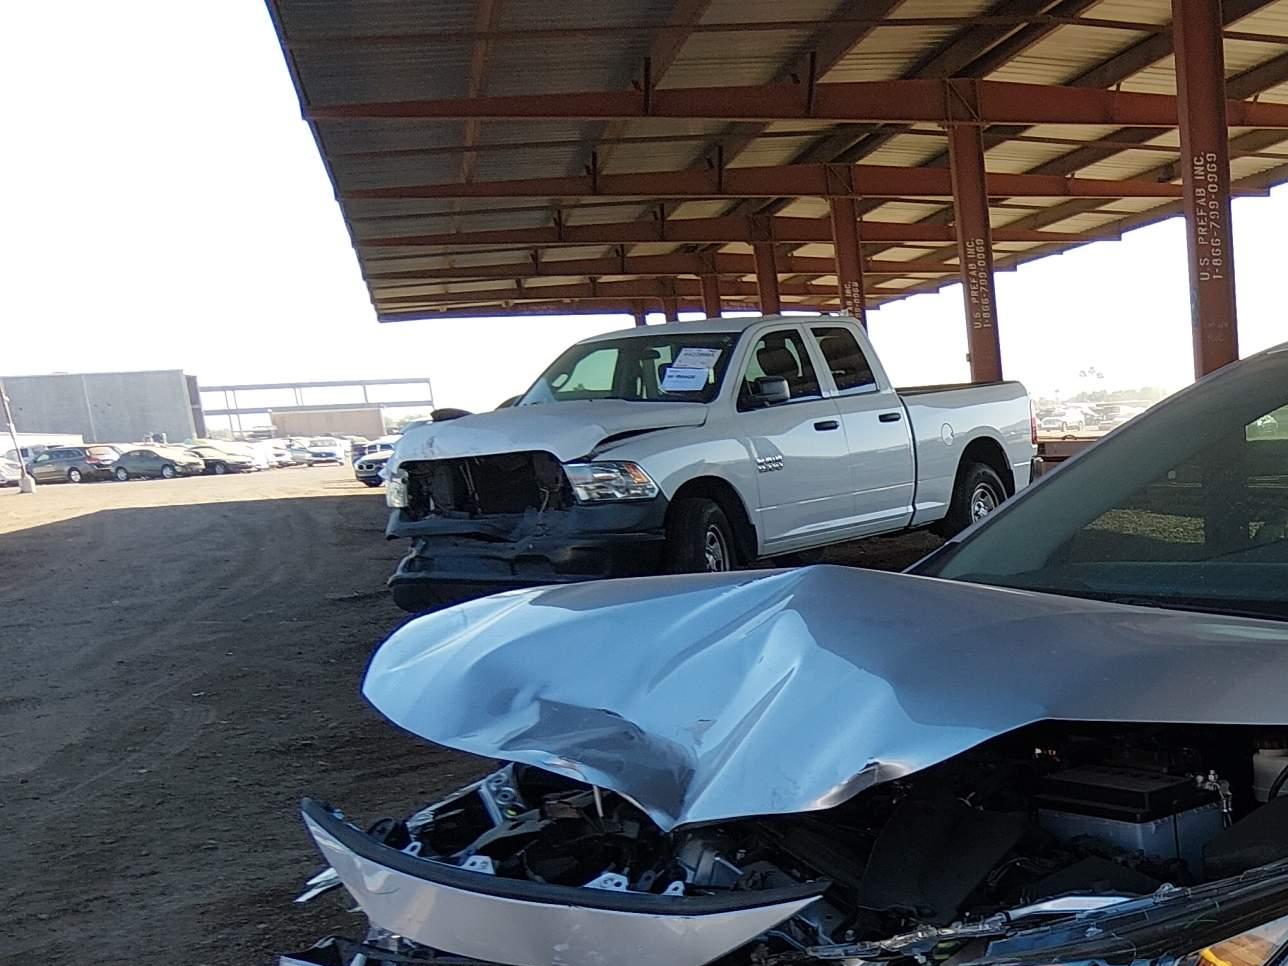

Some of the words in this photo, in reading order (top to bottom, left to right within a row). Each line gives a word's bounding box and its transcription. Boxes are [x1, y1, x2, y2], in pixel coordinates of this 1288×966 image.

[1193, 151, 1205, 182] INC.
[1195, 188, 1209, 245] PREFAB
[1206, 152, 1223, 281] 1-866-799-0969
[967, 263, 980, 304] PREFAB
